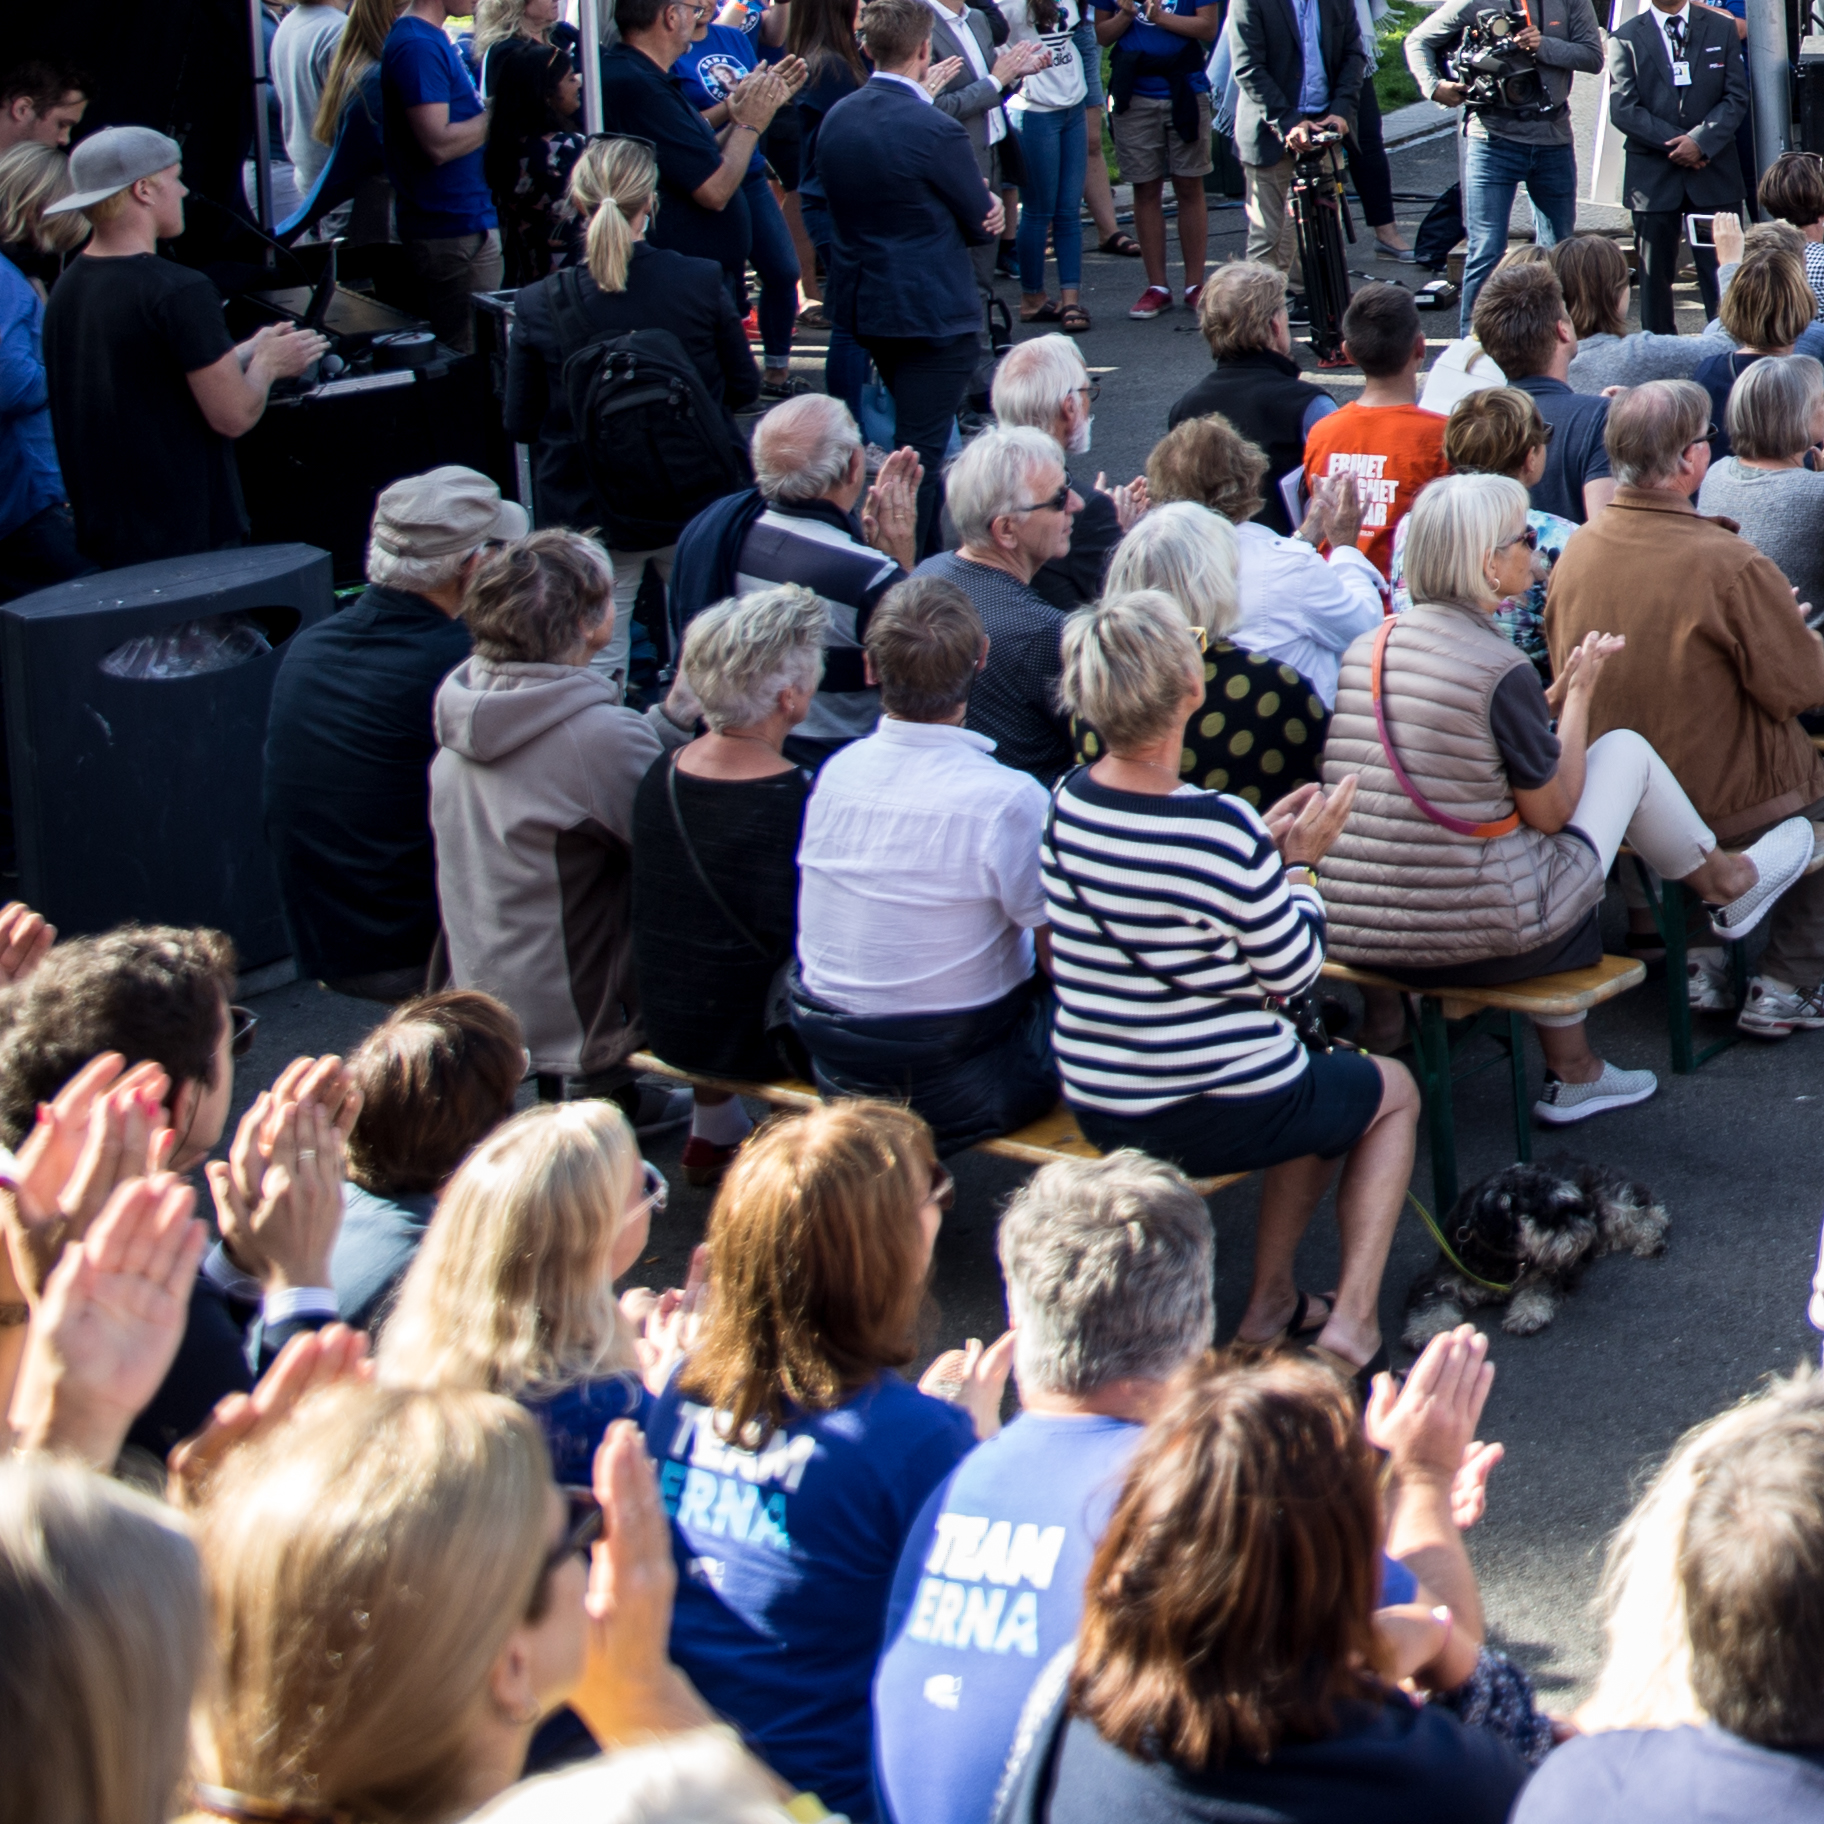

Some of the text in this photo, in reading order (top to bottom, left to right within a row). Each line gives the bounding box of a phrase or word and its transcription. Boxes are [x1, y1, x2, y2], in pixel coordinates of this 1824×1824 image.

[1328, 452, 1388, 479] FRIHET
[669, 1400, 816, 1494] TEAM
[660, 1459, 791, 1551] ERNA
[925, 1512, 1066, 1591] TEAM
[908, 1577, 1038, 1658] ERNA
